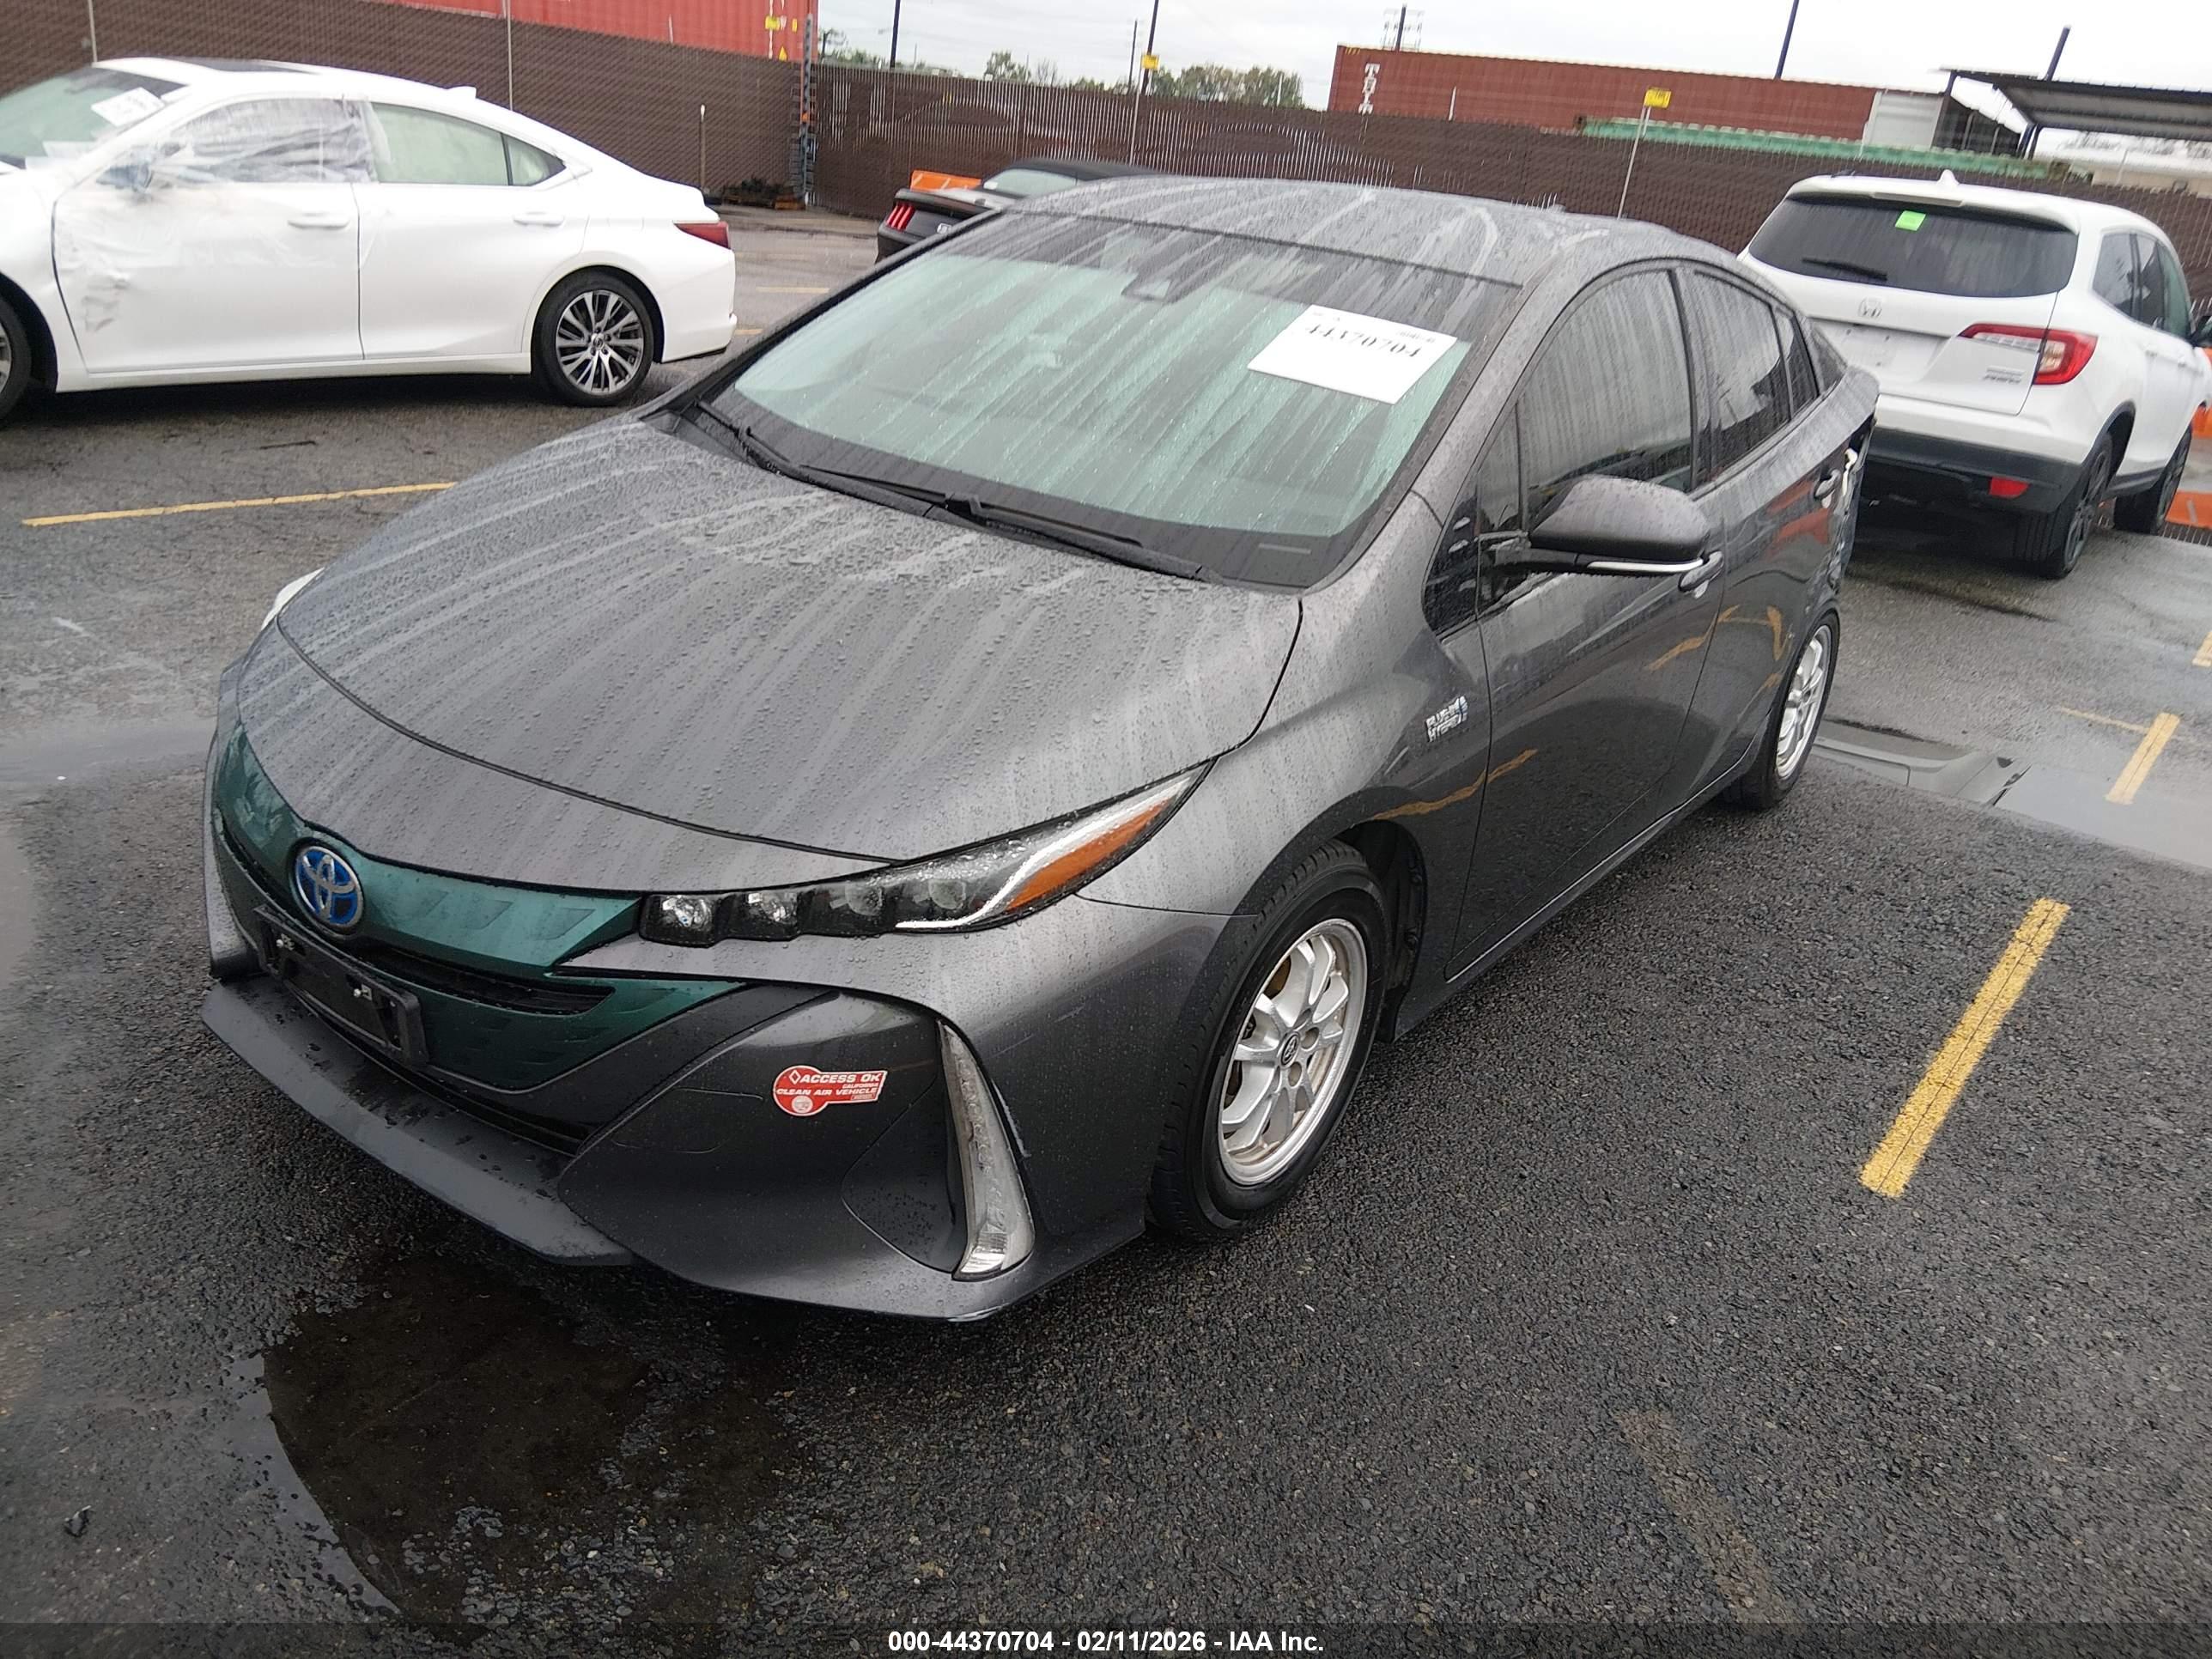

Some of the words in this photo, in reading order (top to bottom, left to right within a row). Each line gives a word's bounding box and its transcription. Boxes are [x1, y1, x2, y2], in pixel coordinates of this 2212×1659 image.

[799, 1074, 857, 1084] ACCESS
[860, 1073, 882, 1082] OK
[836, 1087, 878, 1096] VEHICLE
